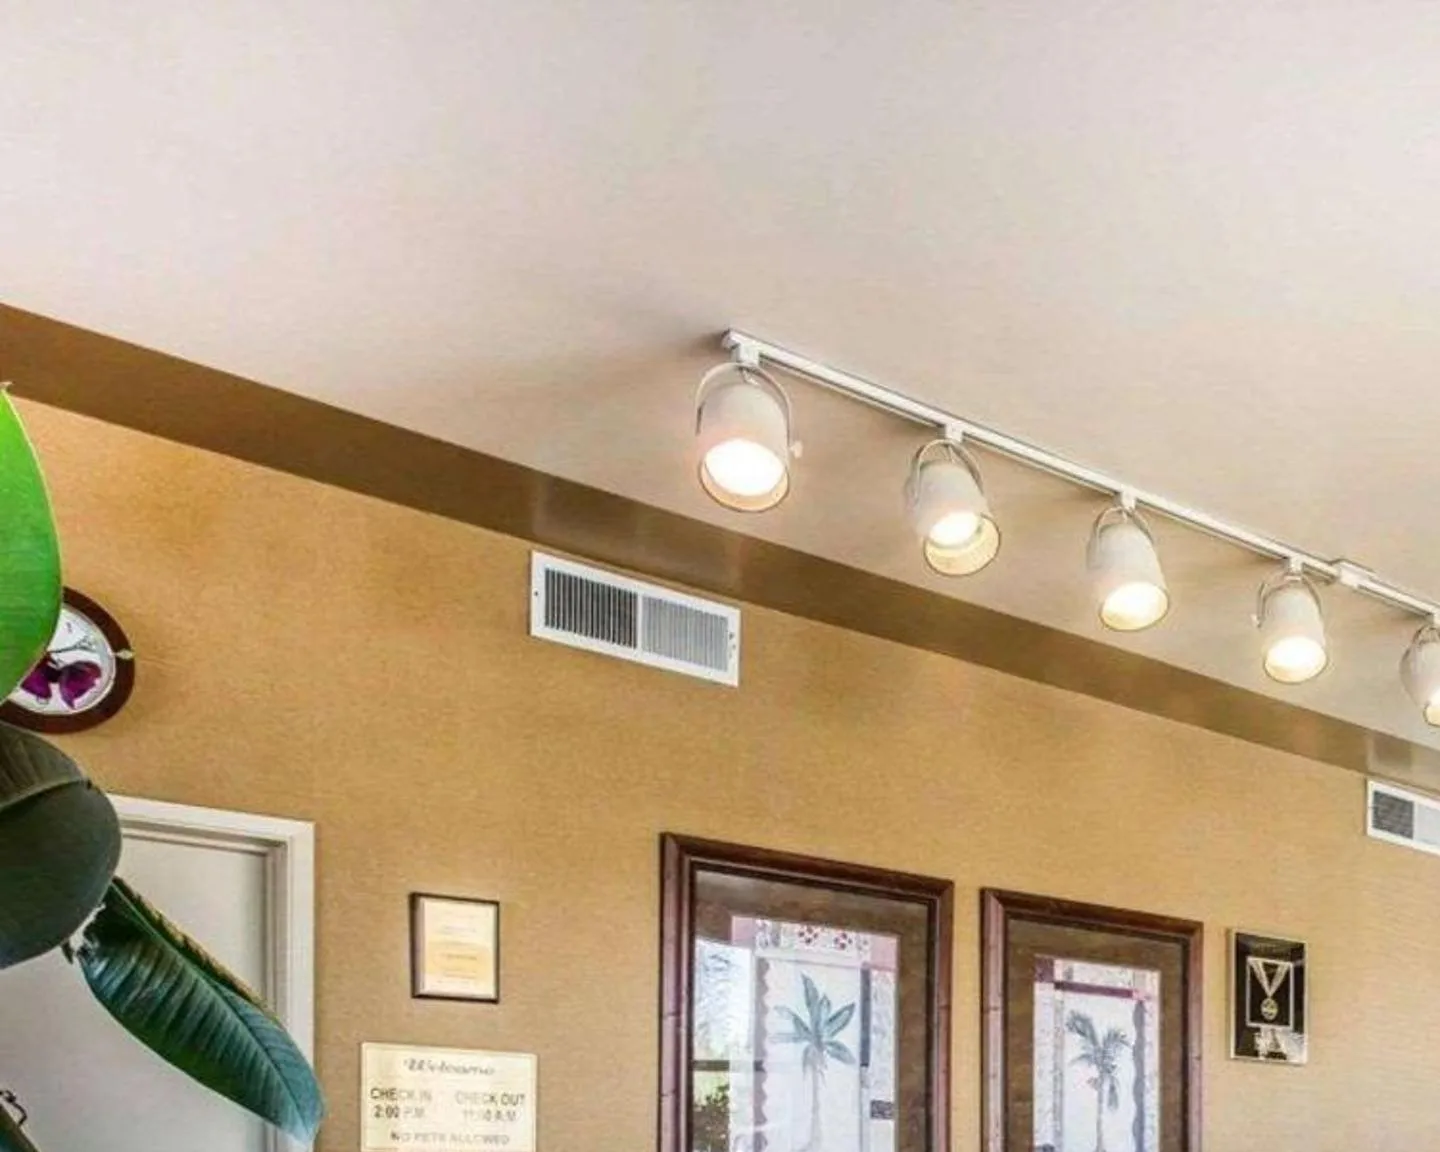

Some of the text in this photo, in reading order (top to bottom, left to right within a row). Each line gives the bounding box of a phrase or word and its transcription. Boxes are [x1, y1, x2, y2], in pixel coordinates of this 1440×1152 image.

[370, 1086, 433, 1103] CHECK IN
[455, 1090, 526, 1107] CHECK OUT
[390, 1130, 411, 1142] NO
[450, 1132, 510, 1146] ALLOWED
